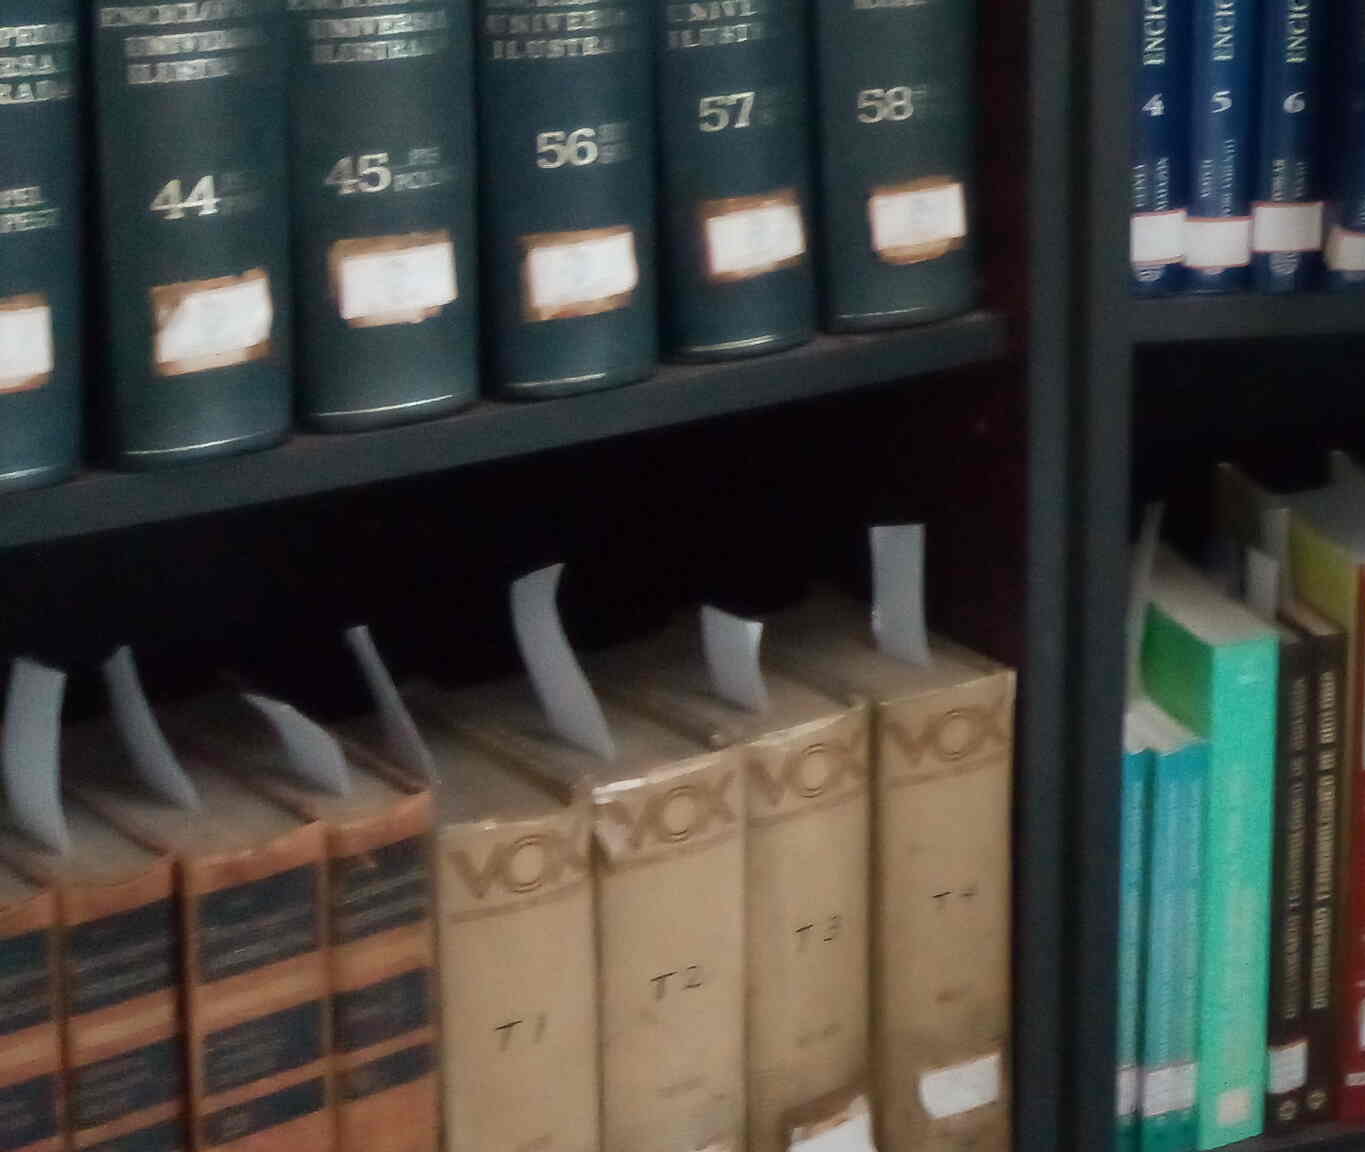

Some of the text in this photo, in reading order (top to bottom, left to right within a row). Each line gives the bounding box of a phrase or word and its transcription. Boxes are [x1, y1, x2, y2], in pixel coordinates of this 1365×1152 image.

[698, 91, 757, 133] 57
[856, 86, 914, 124] 58
[1142, 94, 1165, 117] 4
[1210, 90, 1233, 114] 5
[1284, 92, 1306, 114] 6
[535, 127, 599, 170] 56
[324, 151, 392, 196] 45
[149, 175, 222, 220] 44
[880, 701, 1009, 766] VOX
[747, 715, 867, 807] VOX
[606, 773, 742, 848] VOX
[449, 813, 597, 899] VOX
